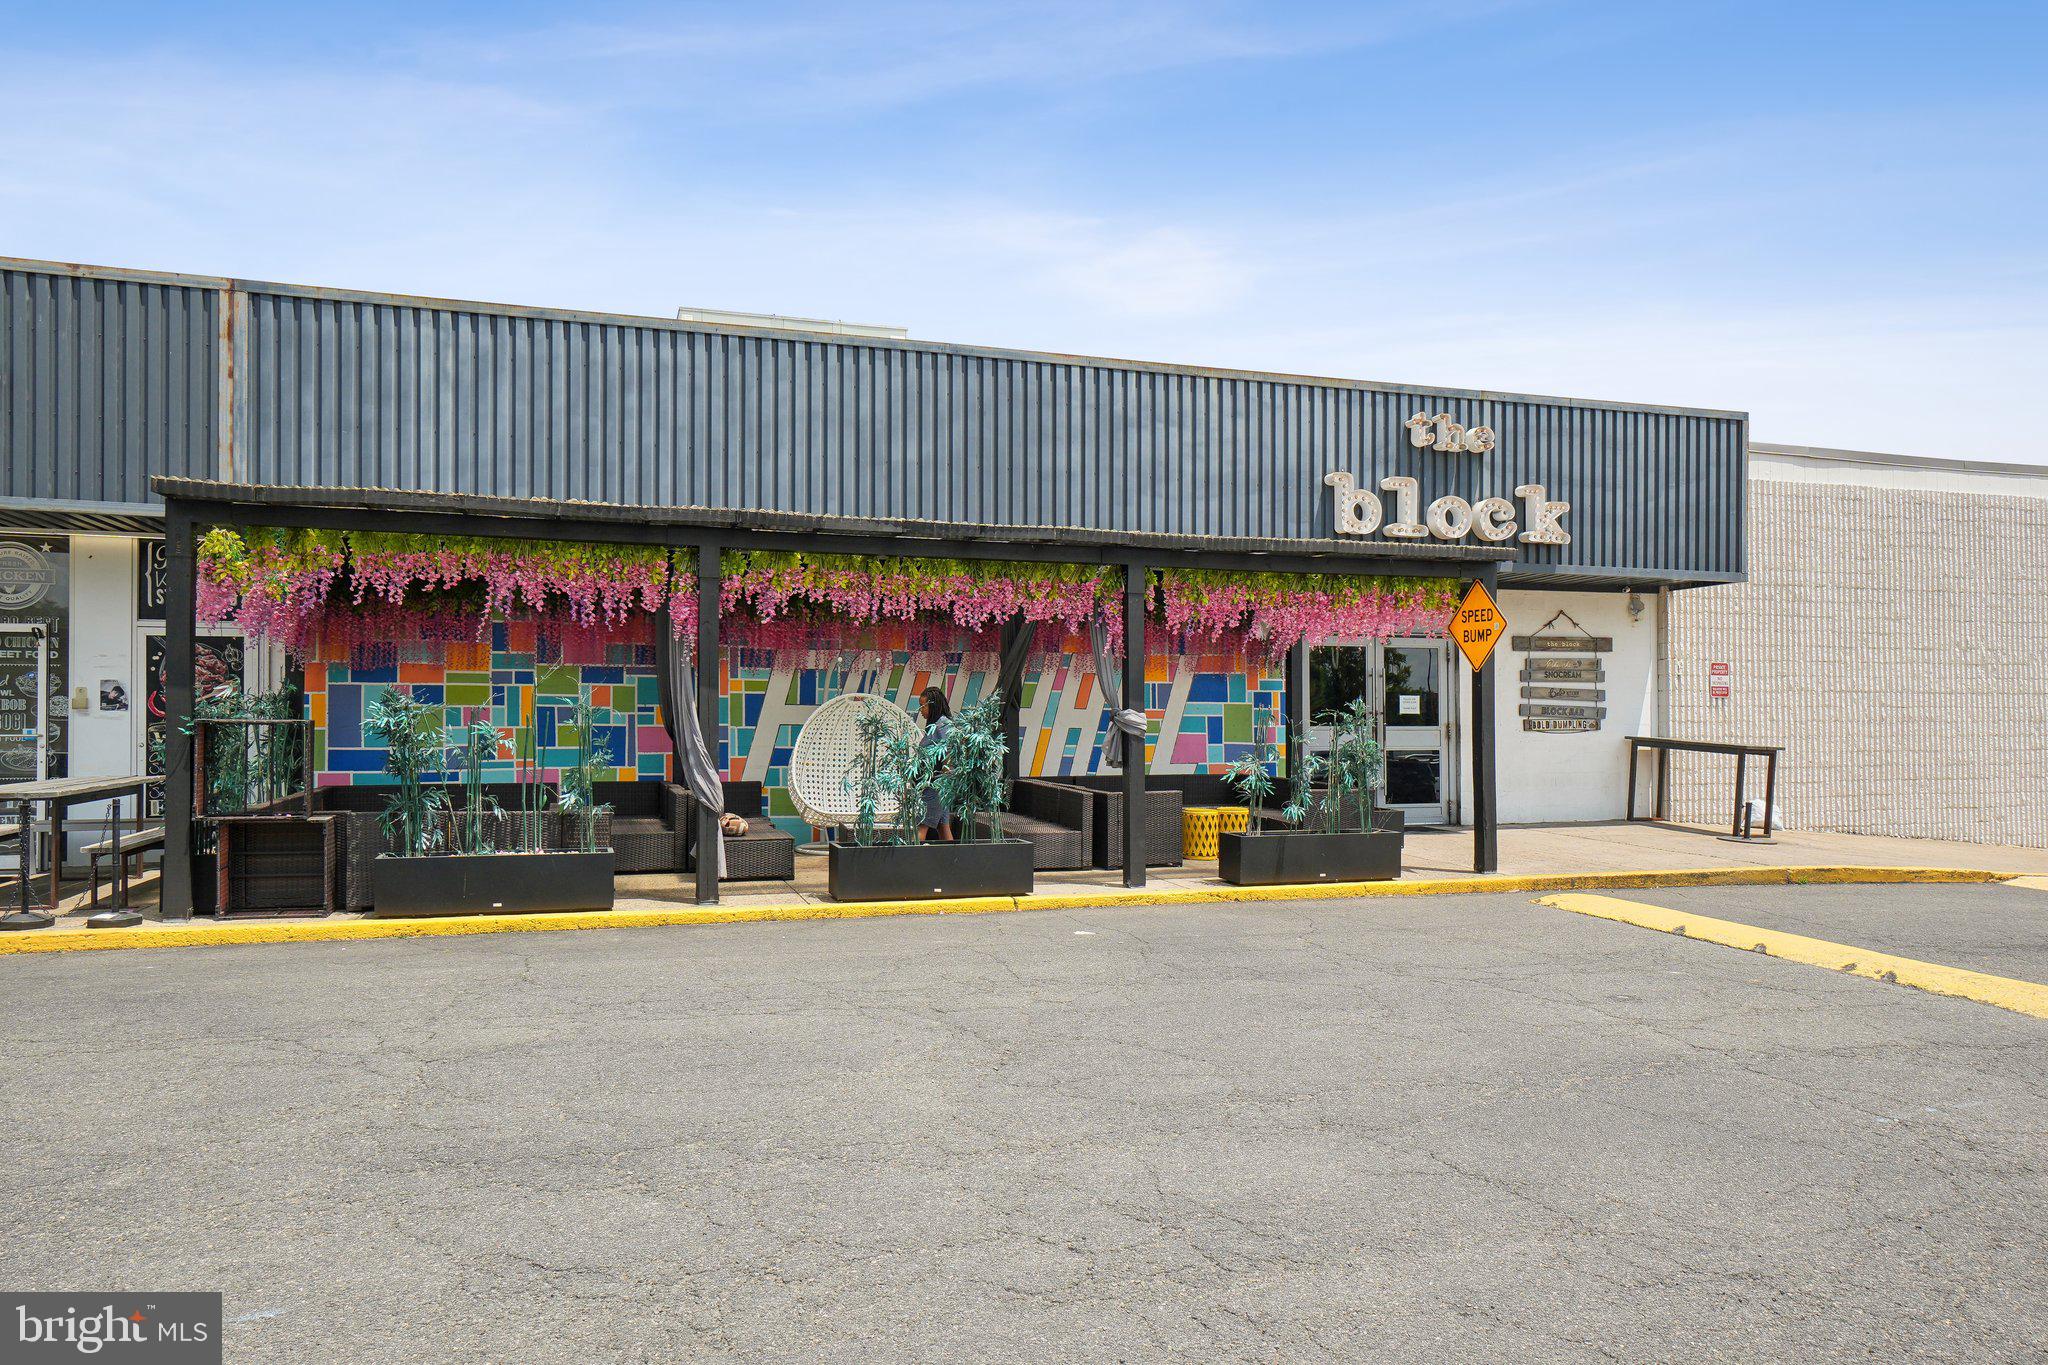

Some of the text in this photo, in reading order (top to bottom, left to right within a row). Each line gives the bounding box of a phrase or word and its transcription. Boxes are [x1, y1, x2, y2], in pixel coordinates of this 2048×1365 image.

[1405, 411, 1495, 454] the
[1324, 471, 1571, 545] block
[1461, 608, 1494, 624] SPEED
[5, 636, 59, 649] CHICN
[1463, 628, 1493, 643] BUMP
[26, 650, 59, 659] FOD
[1544, 671, 1582, 679] SNOCREAM
[1541, 706, 1585, 717] BLOCK BAR
[0, 713, 27, 731] OGI
[1553, 720, 1587, 729] DUMPLING
